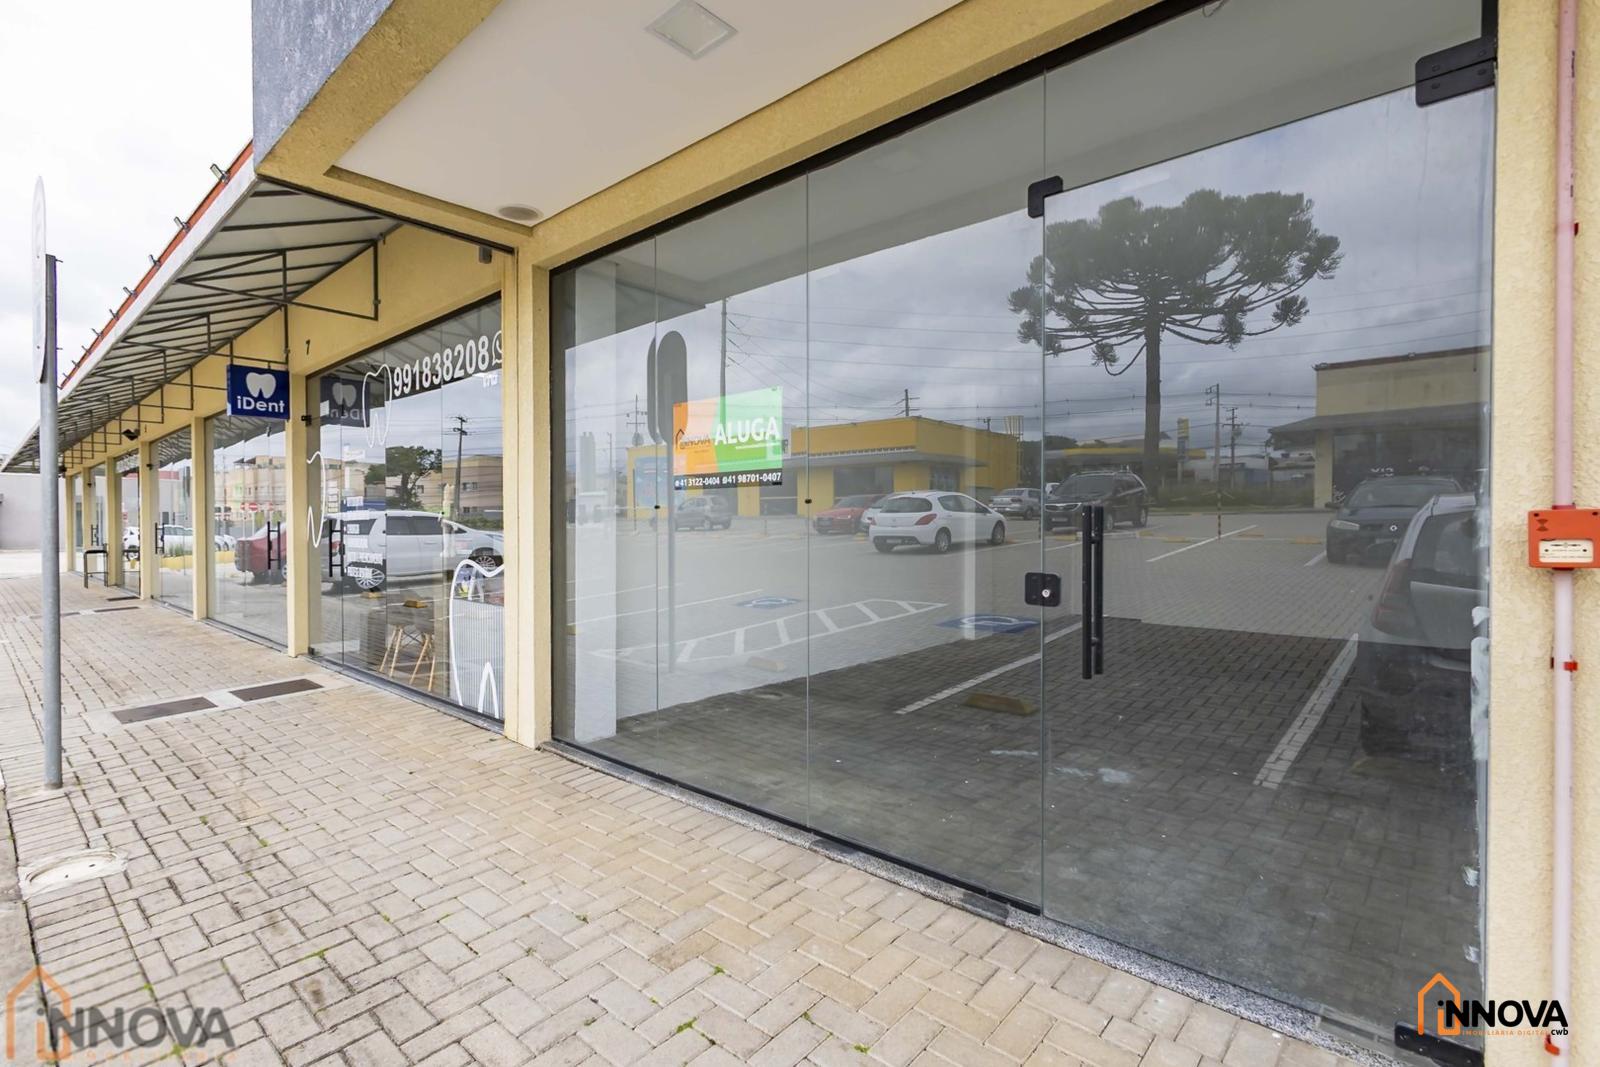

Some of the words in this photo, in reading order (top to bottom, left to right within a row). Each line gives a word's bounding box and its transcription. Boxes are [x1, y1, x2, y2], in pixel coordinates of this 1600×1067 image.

[393, 335, 490, 397] 991838208
[237, 396, 285, 413] iDent
[714, 416, 780, 446] ALUGA
[737, 472, 782, 484] 98701-0407
